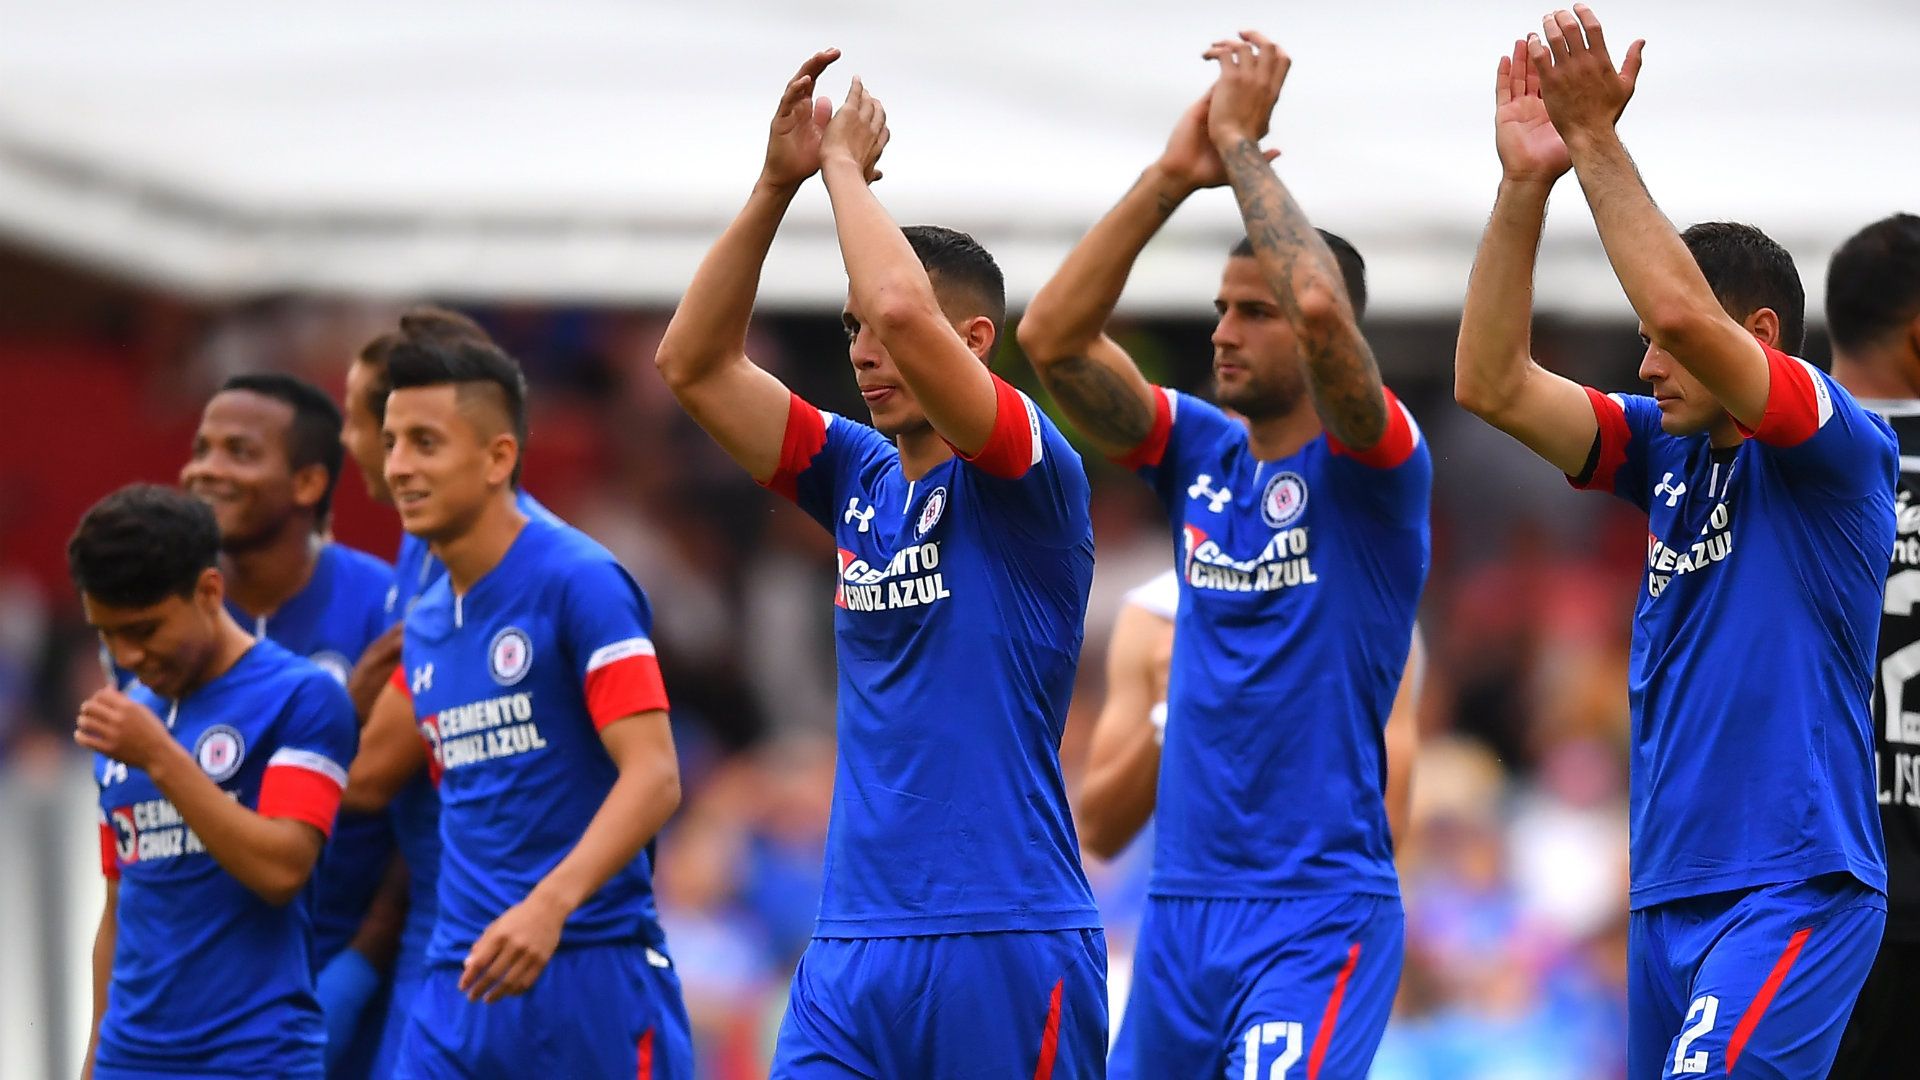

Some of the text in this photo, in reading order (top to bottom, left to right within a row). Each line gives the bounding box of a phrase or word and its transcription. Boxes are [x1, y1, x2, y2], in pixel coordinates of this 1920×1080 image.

[845, 573, 950, 611] CRUZ AZUL
[1190, 556, 1317, 592] CRUZ AZUL
[438, 693, 532, 738] CEMENTO
[443, 722, 546, 769] CRUZ AZUL
[1243, 1021, 1303, 1080] 17
[1671, 995, 1719, 1075] 2
